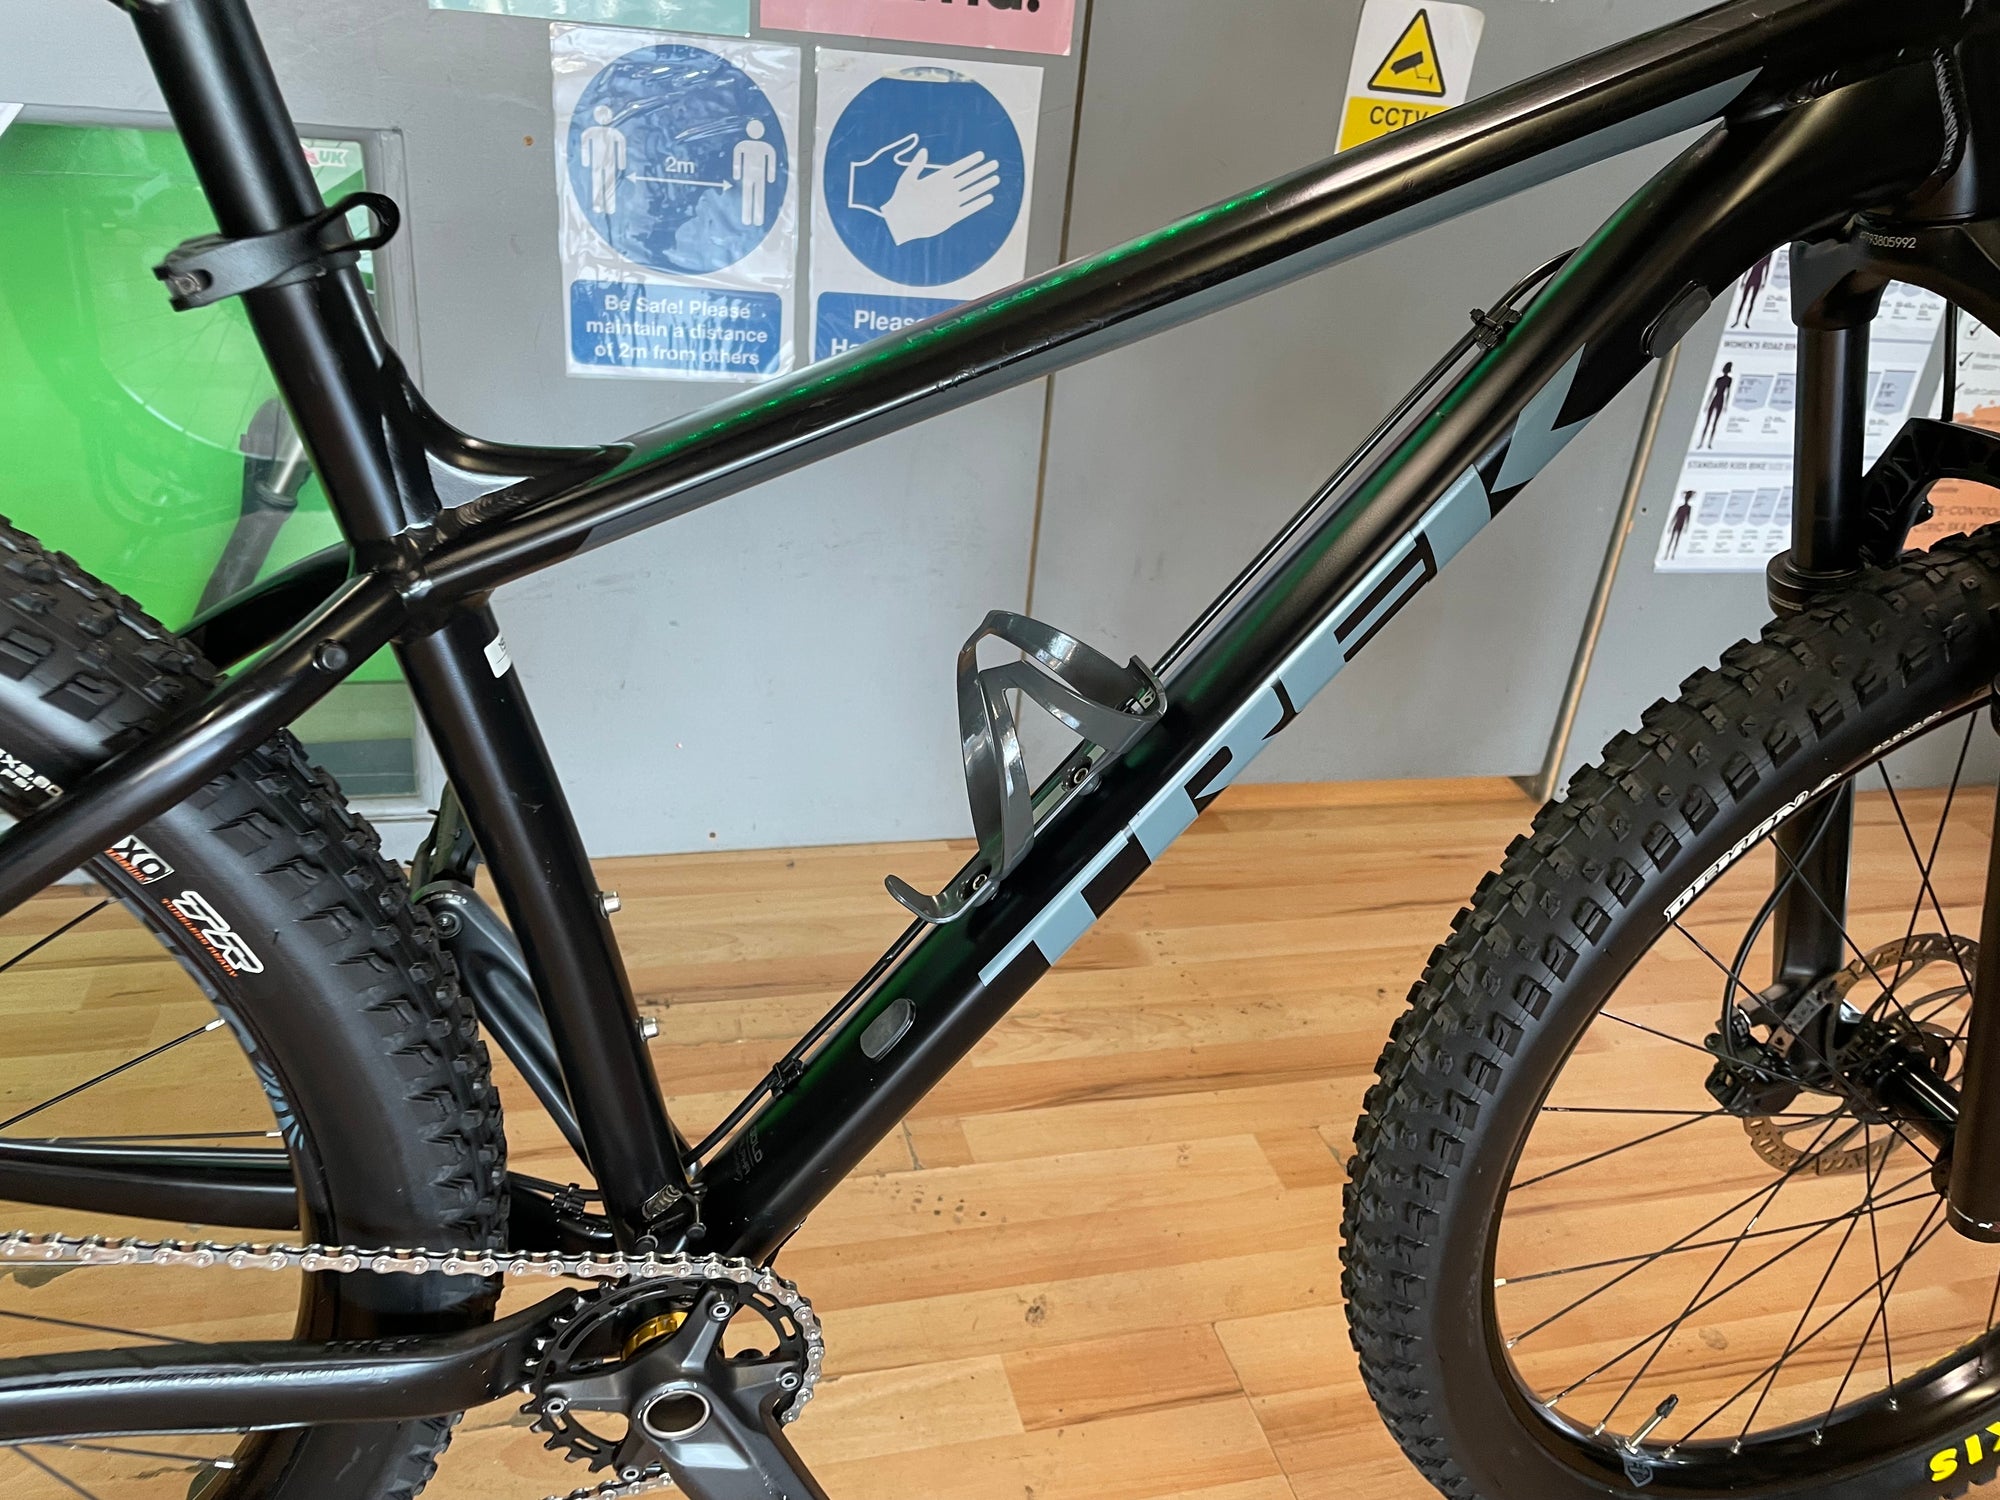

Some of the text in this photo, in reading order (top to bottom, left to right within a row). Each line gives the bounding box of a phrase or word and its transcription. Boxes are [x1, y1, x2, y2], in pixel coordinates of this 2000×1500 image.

[1370, 106, 1428, 127] CCTV
[320, 149, 344, 164] UK
[665, 156, 695, 174] 2m
[604, 294, 751, 320] Be Safe! Please
[586, 319, 768, 344] maintain a distance
[854, 309, 926, 332] Pleas
[594, 341, 760, 366] of 2m from others
[978, 341, 1594, 987] TREK
[109, 837, 170, 880] XO
